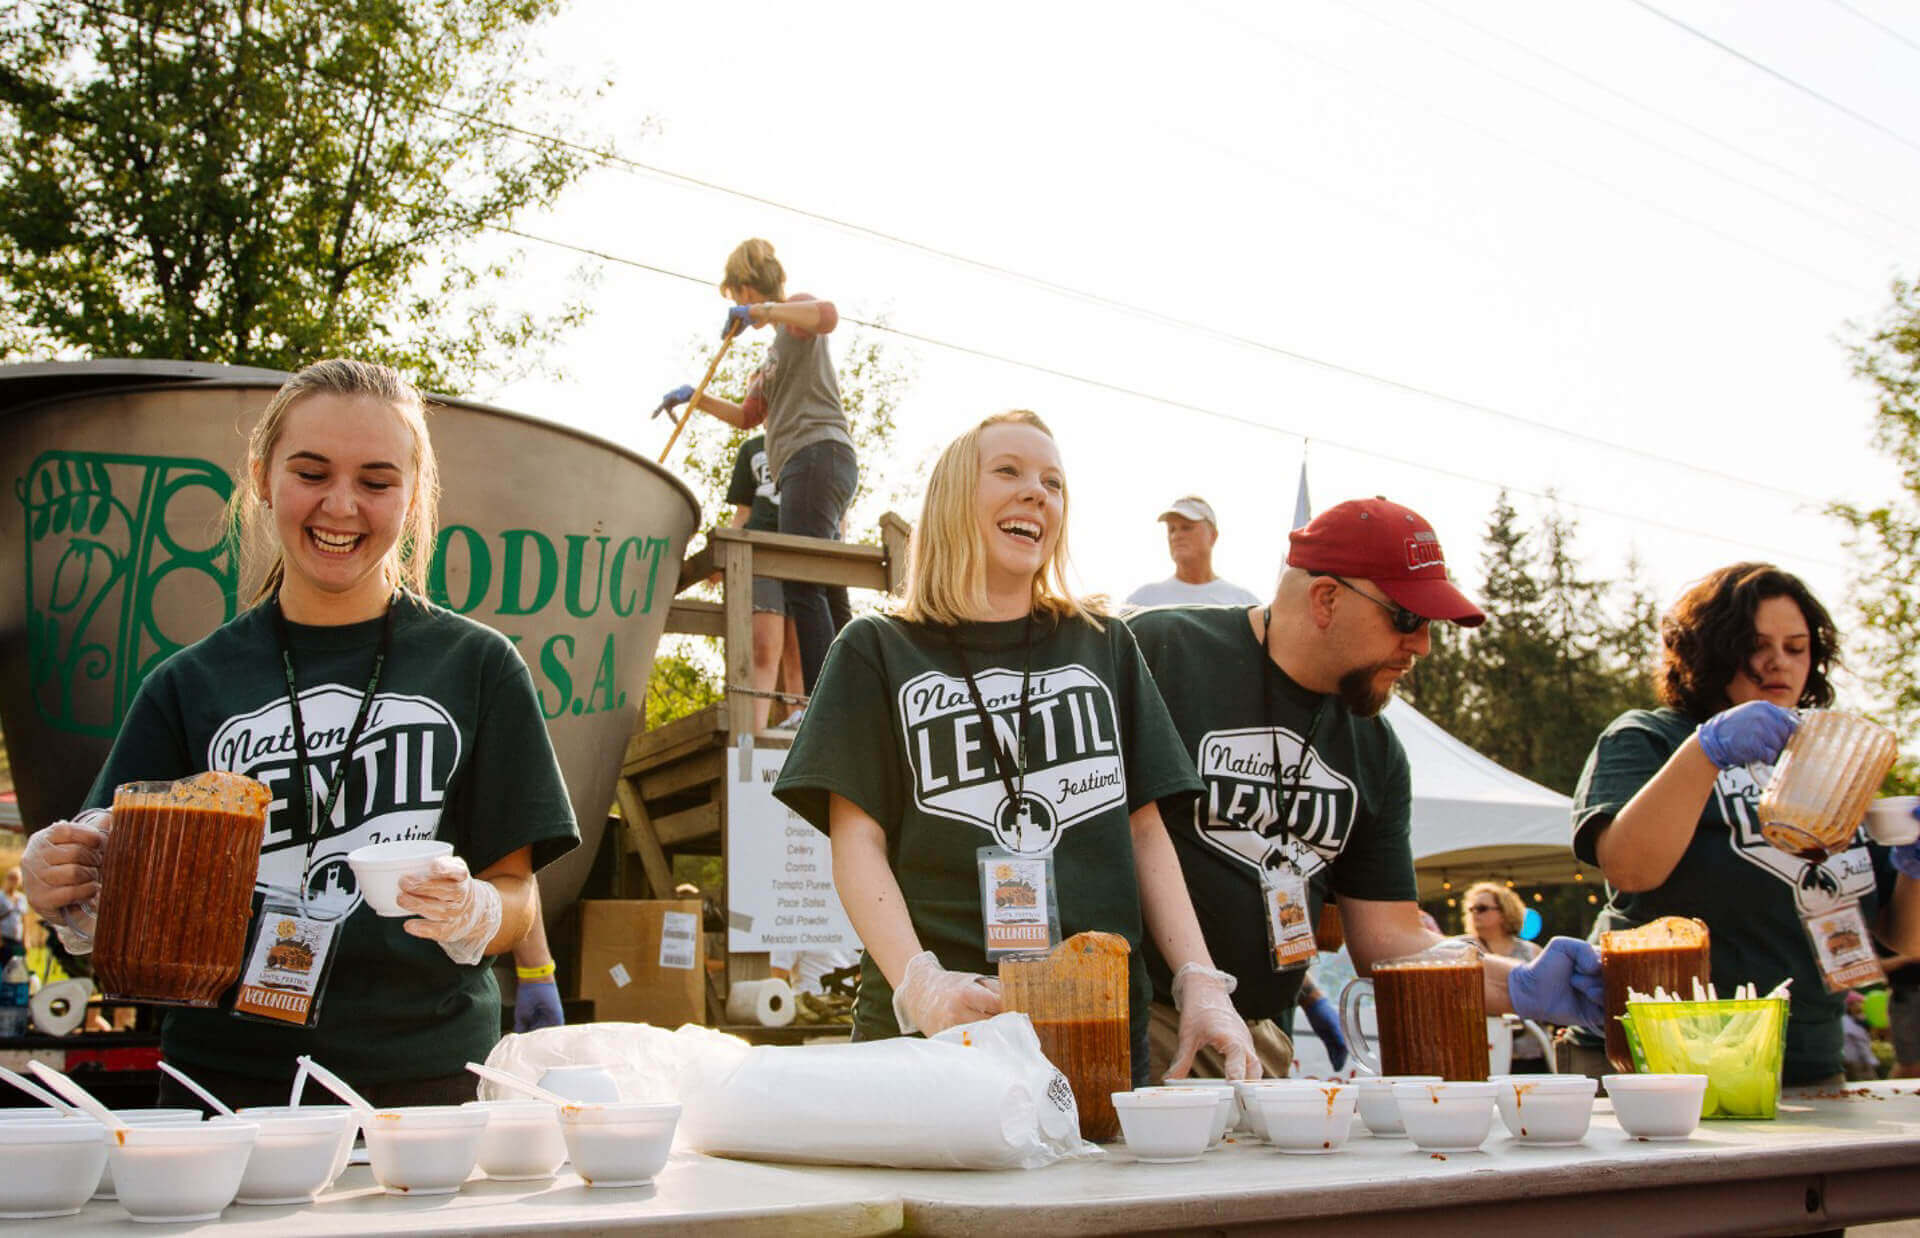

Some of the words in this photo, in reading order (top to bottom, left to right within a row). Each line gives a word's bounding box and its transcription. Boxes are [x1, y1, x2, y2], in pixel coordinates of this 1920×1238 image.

[428, 523, 671, 619] ODUCT
[503, 632, 627, 720] S.A.
[913, 677, 1052, 717] Naonl
[221, 702, 384, 765] Natonl
[917, 691, 1114, 793] LENTIL
[256, 730, 446, 847] ENTIL
[1056, 766, 1121, 804] Festival
[1207, 780, 1341, 848] LENTIL
[244, 987, 310, 1013] VOLUNTEER
